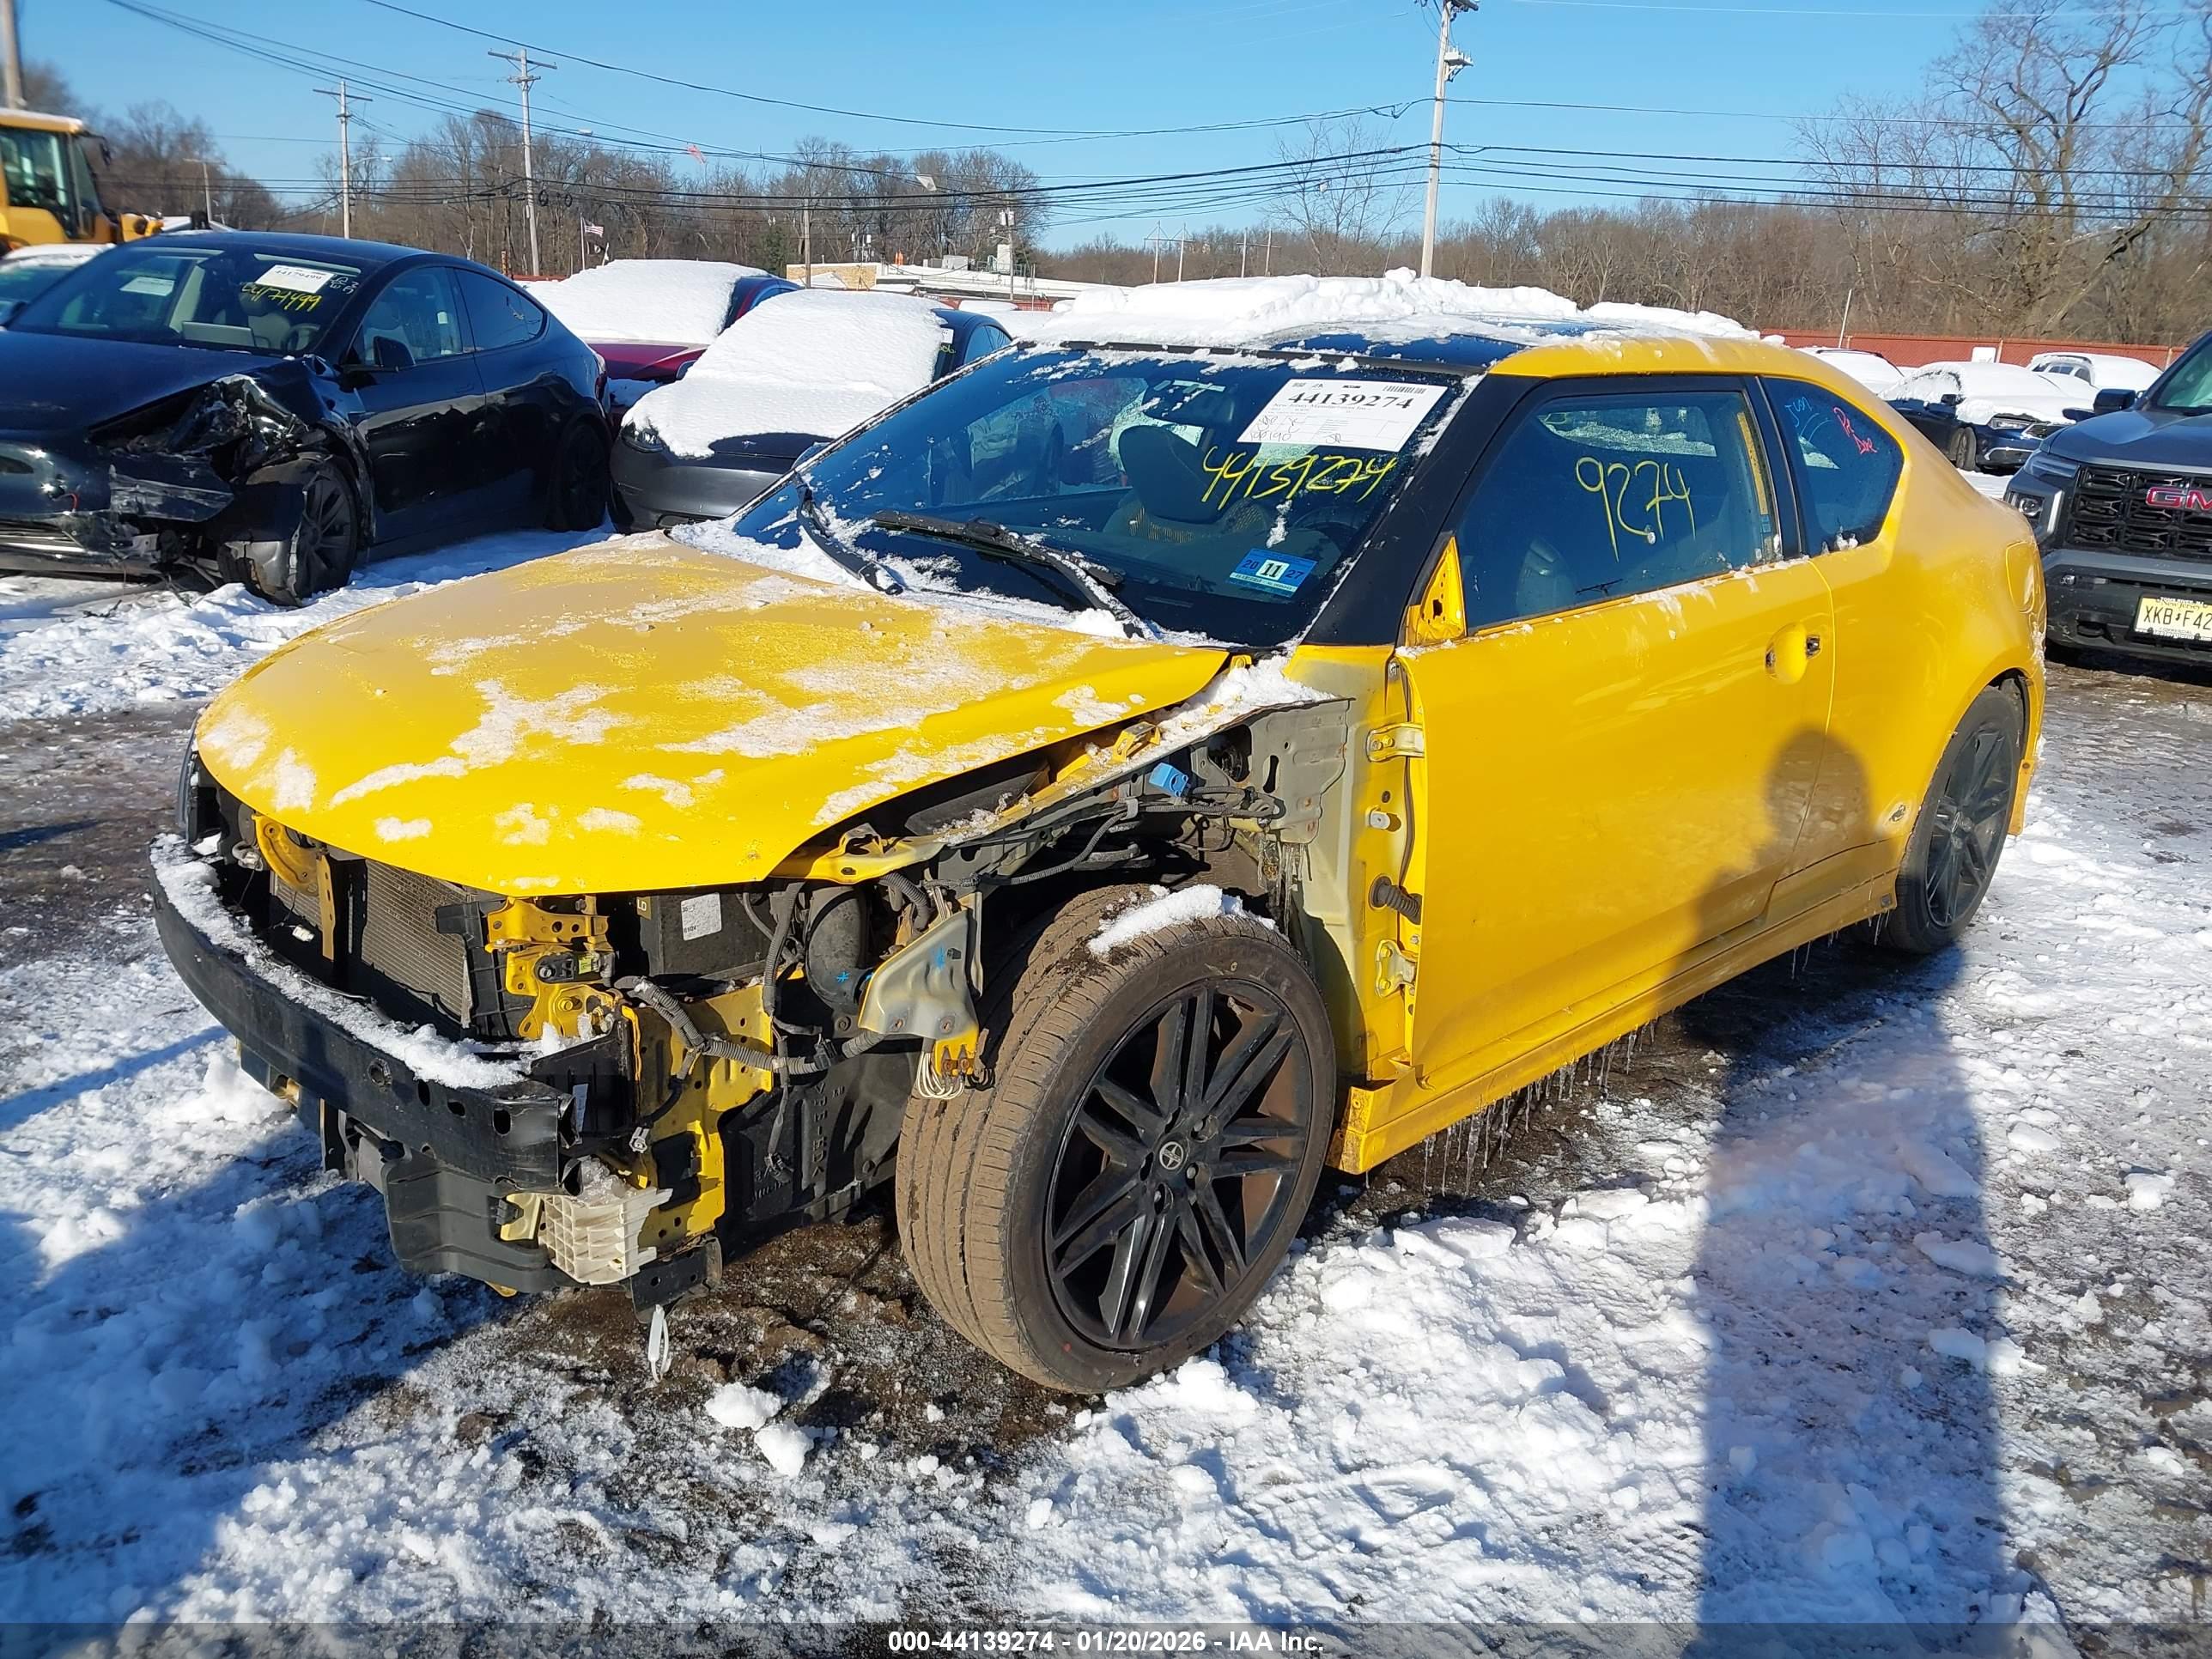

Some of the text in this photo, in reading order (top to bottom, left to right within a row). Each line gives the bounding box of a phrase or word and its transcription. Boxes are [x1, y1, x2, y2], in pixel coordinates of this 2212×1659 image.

[1287, 392, 1414, 409] 44139274
[1576, 457, 1696, 563] 9274
[1243, 559, 1304, 580] 20 11 27
